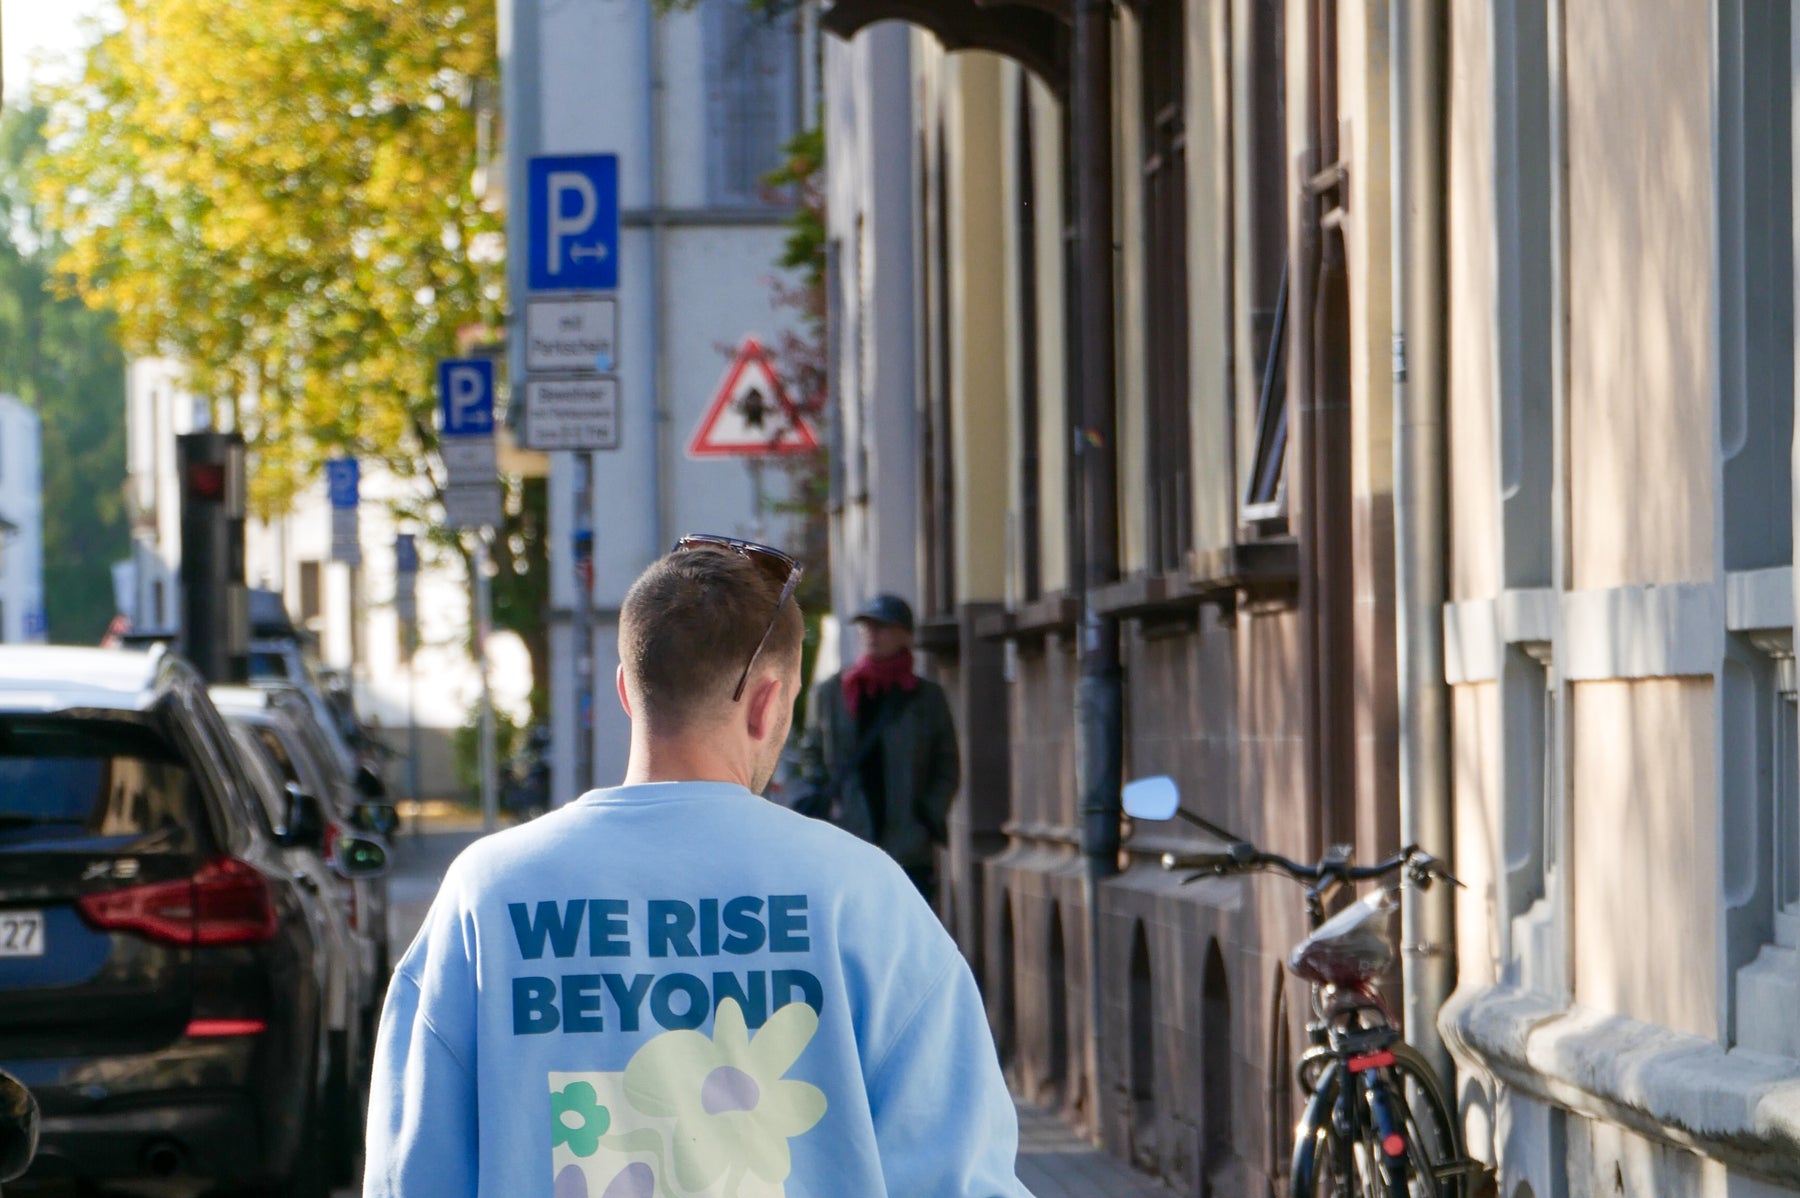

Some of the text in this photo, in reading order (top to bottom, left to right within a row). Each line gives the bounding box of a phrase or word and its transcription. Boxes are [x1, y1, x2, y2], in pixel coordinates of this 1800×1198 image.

[547, 171, 598, 275] P
[450, 366, 486, 430] P
[4, 919, 37, 950] 27
[507, 895, 811, 960] WE RISE
[512, 969, 824, 1035] BEYOND
